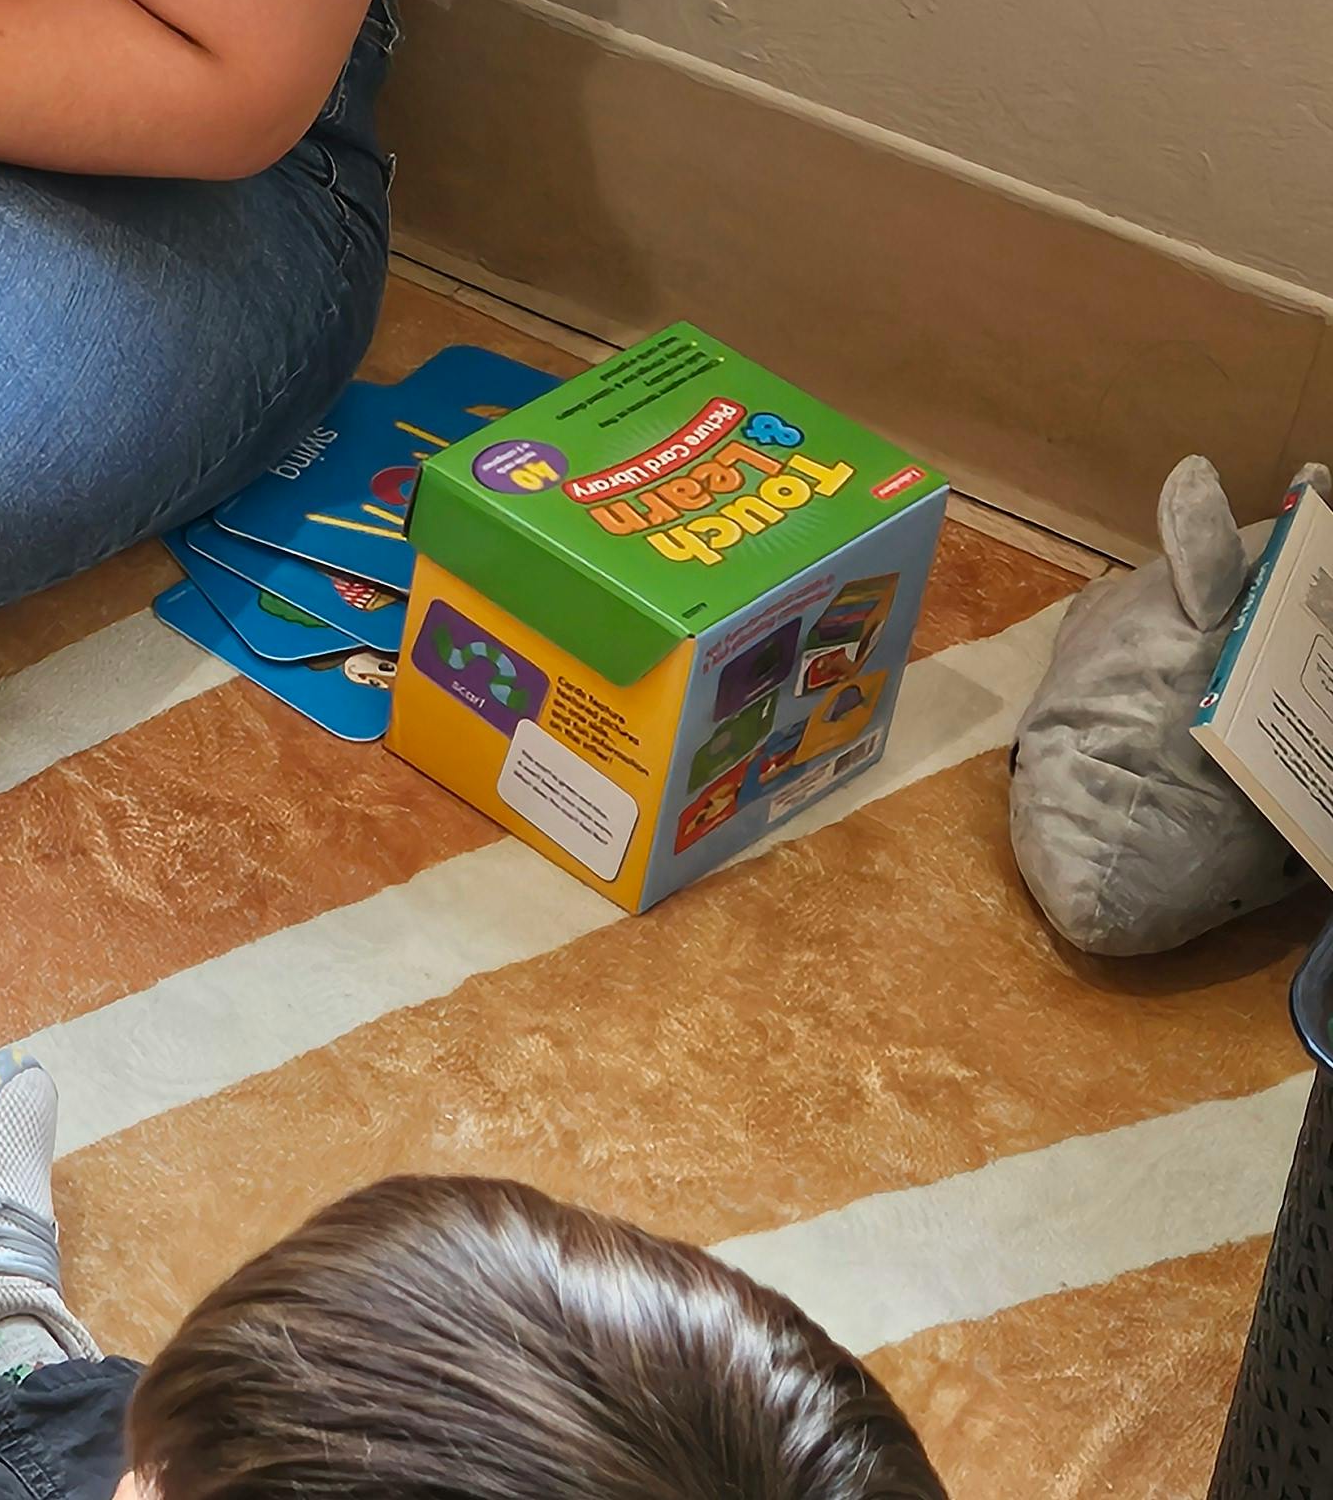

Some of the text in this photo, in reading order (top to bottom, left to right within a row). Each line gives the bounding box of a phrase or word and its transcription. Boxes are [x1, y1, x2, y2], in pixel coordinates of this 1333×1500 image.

[267, 426, 338, 480] swing
[572, 402, 737, 498] Picture Card Library
[743, 411, 805, 448] &
[509, 460, 561, 491] 40
[588, 440, 784, 536] Learn
[646, 454, 856, 566] Touch
